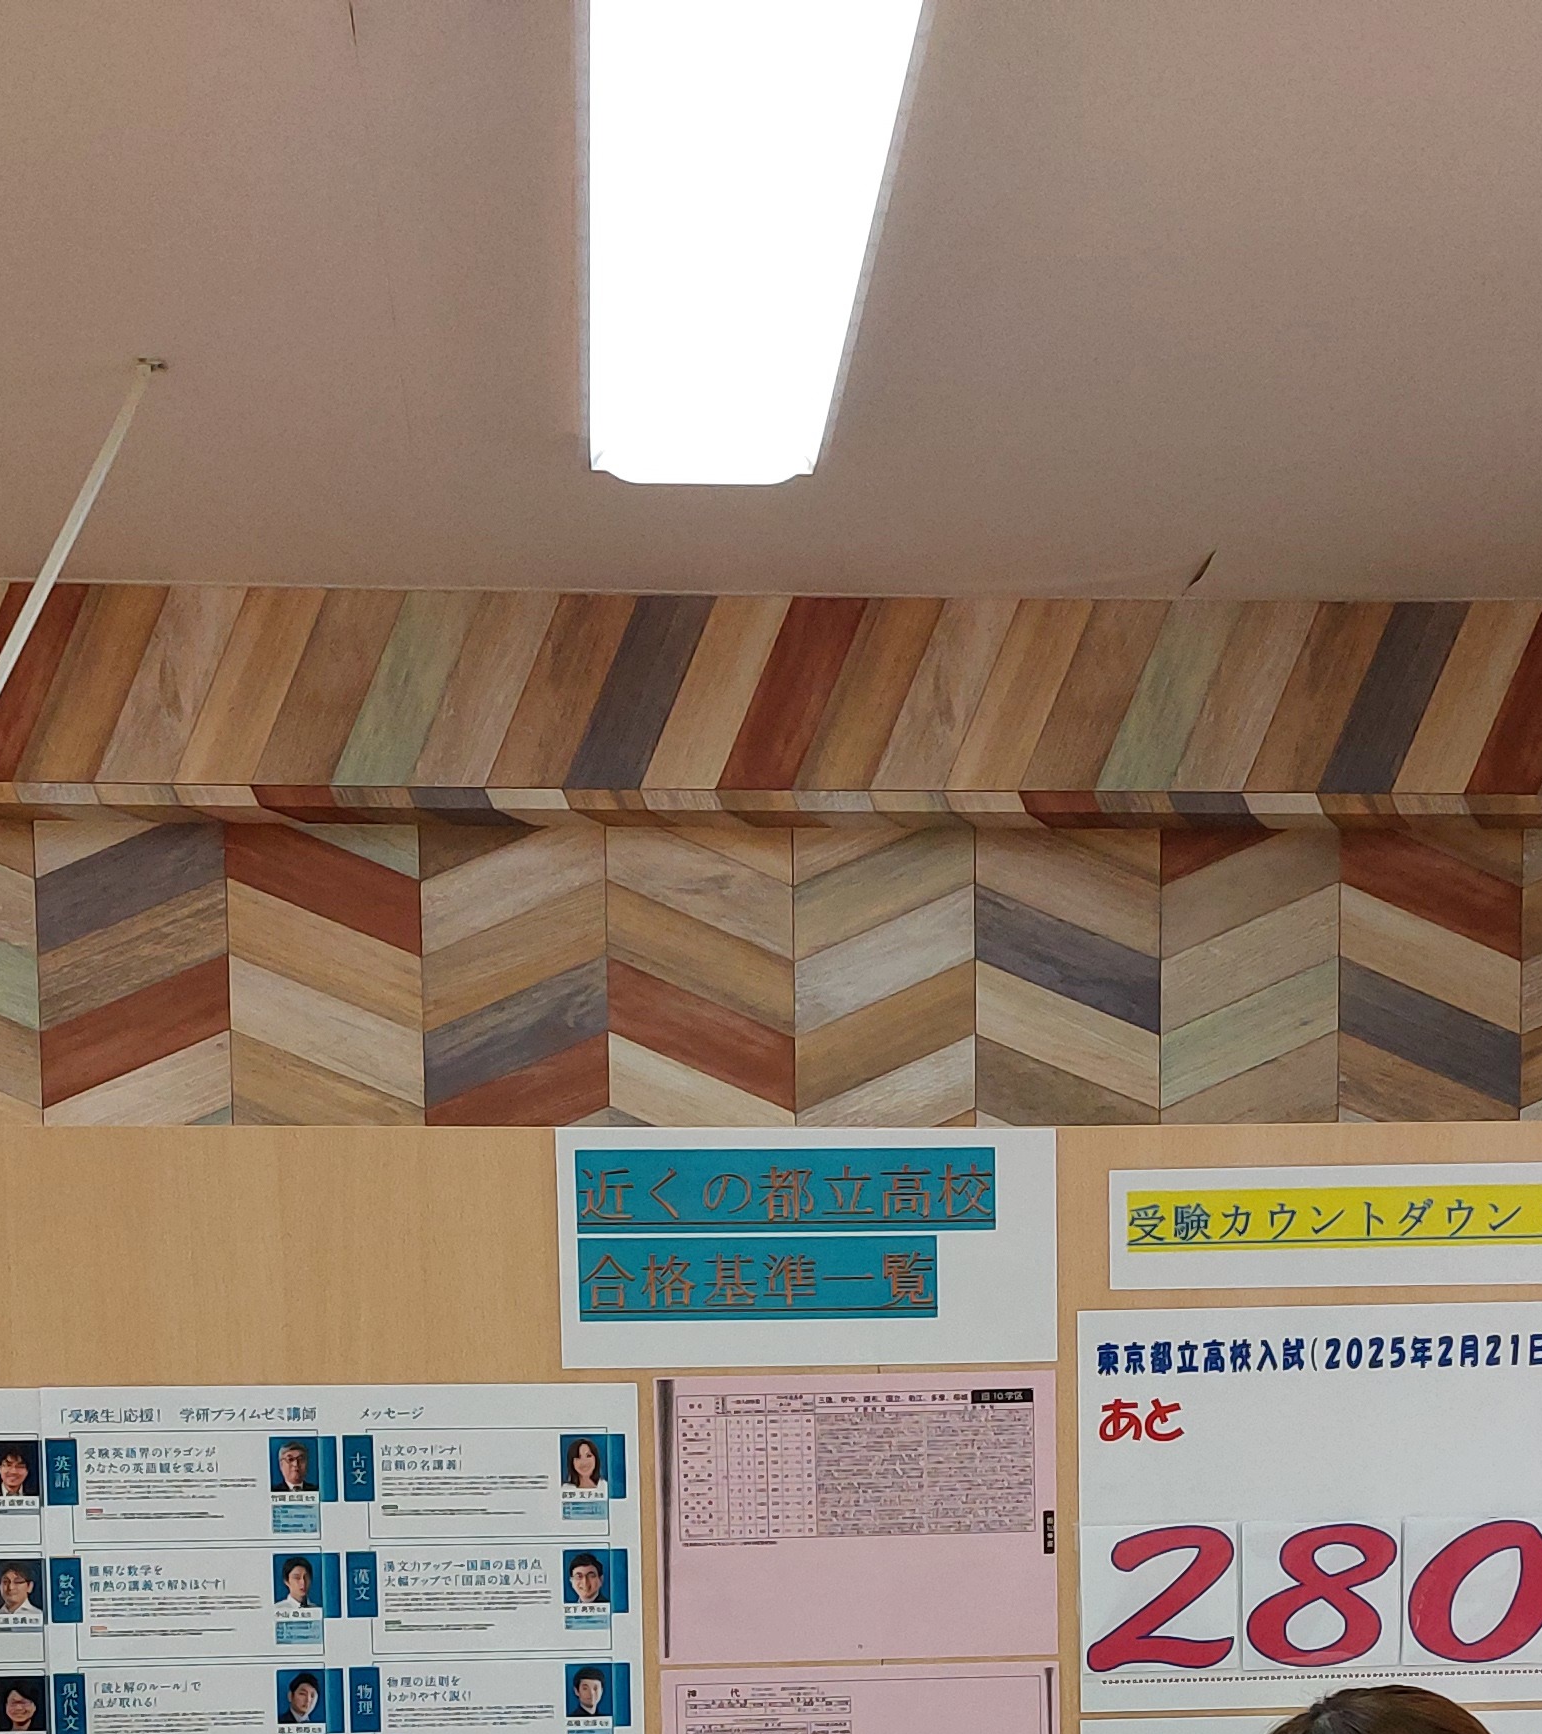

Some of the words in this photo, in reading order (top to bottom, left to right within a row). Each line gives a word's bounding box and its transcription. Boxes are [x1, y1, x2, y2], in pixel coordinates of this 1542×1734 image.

[579, 1162, 995, 1222] 近くの都立高校
[581, 1246, 939, 1310] 合格基準一覧
[360, 1406, 424, 1420] メッセージ
[1098, 1399, 1185, 1444] あと
[53, 1455, 72, 1488] 英語
[349, 1452, 368, 1485] 古文
[58, 1573, 75, 1606] 数学
[62, 1682, 79, 1732] 現代文
[356, 1683, 374, 1716] 物理
